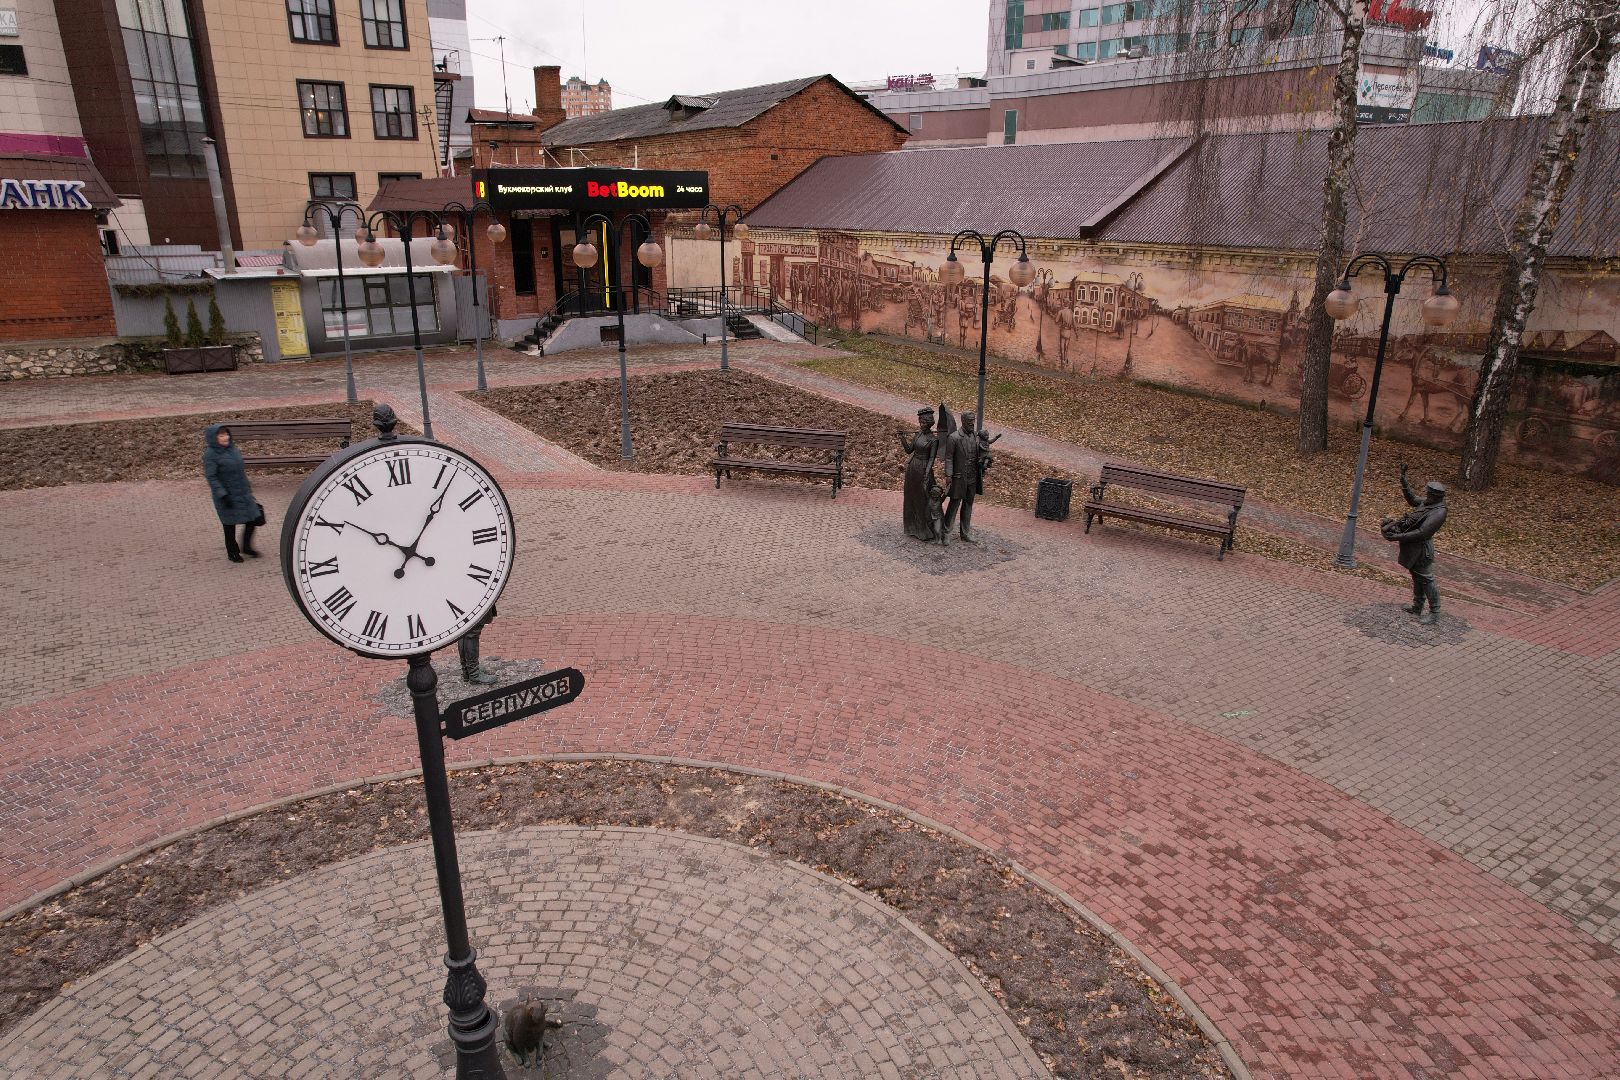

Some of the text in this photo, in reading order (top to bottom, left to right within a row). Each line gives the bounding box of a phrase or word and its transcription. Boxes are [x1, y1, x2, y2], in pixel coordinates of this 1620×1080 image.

[554, 184, 573, 194] клуб
[587, 181, 665, 198] BetBoom
[675, 185, 685, 193] 24
[463, 678, 570, 724] СЕРПУХОВ
